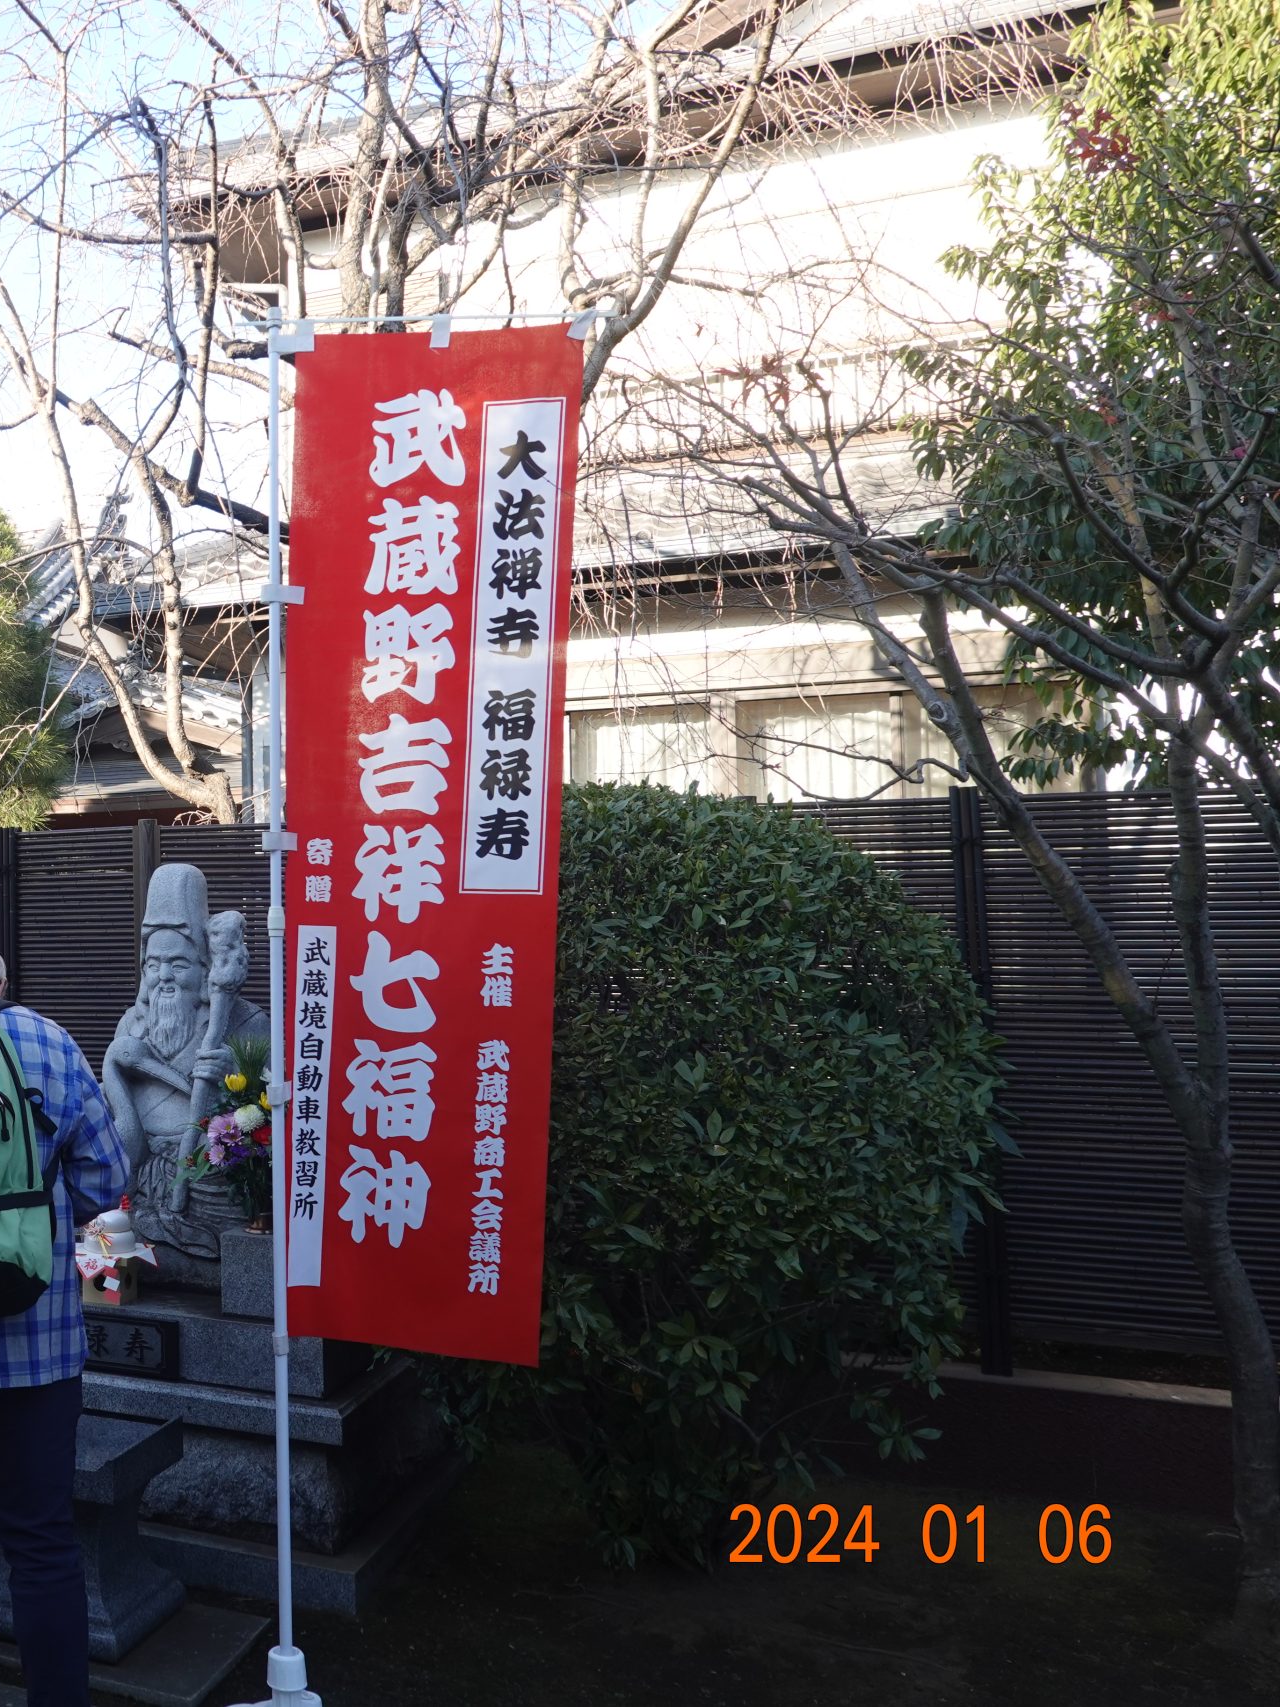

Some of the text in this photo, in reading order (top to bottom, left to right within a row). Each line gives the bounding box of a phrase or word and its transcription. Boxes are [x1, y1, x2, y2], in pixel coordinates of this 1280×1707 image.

[338, 388, 466, 1249] 武蔵野吉祥七福神
[475, 430, 547, 861] 大法禅寺 福禄寿
[304, 837, 333, 903] 寄贈
[293, 936, 330, 1221] 武蔵境自動車教習所
[468, 943, 514, 1296] 主催 武蔵野商工会議所
